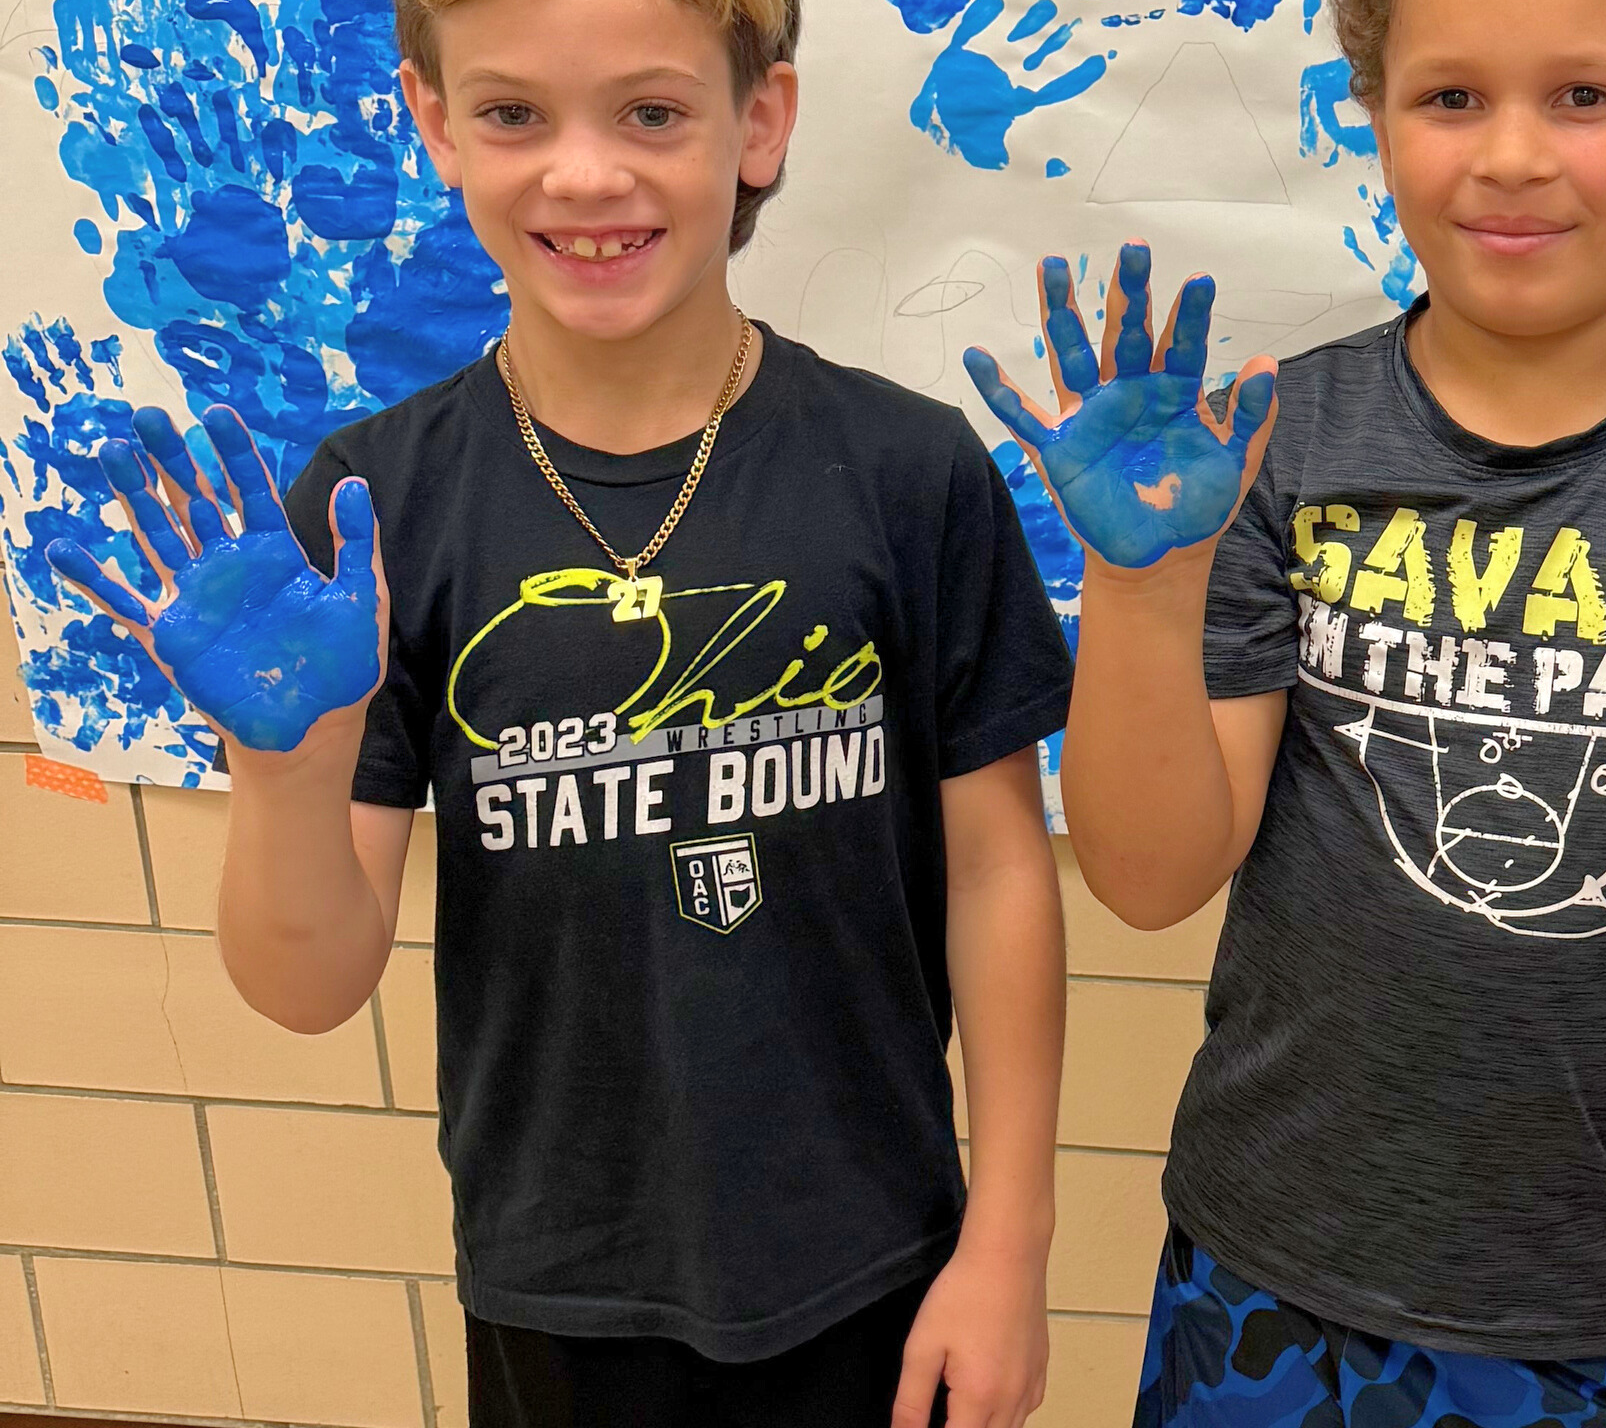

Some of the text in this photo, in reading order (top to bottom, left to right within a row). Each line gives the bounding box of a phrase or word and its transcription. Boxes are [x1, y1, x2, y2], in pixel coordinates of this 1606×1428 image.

[607, 576, 663, 623] 27
[446, 568, 883, 750] Ohio
[1358, 619, 1518, 713] THE
[499, 703, 867, 768] 2023 WRESTLING
[475, 725, 886, 852] STATE BOUND
[688, 859, 711, 916] OAC
